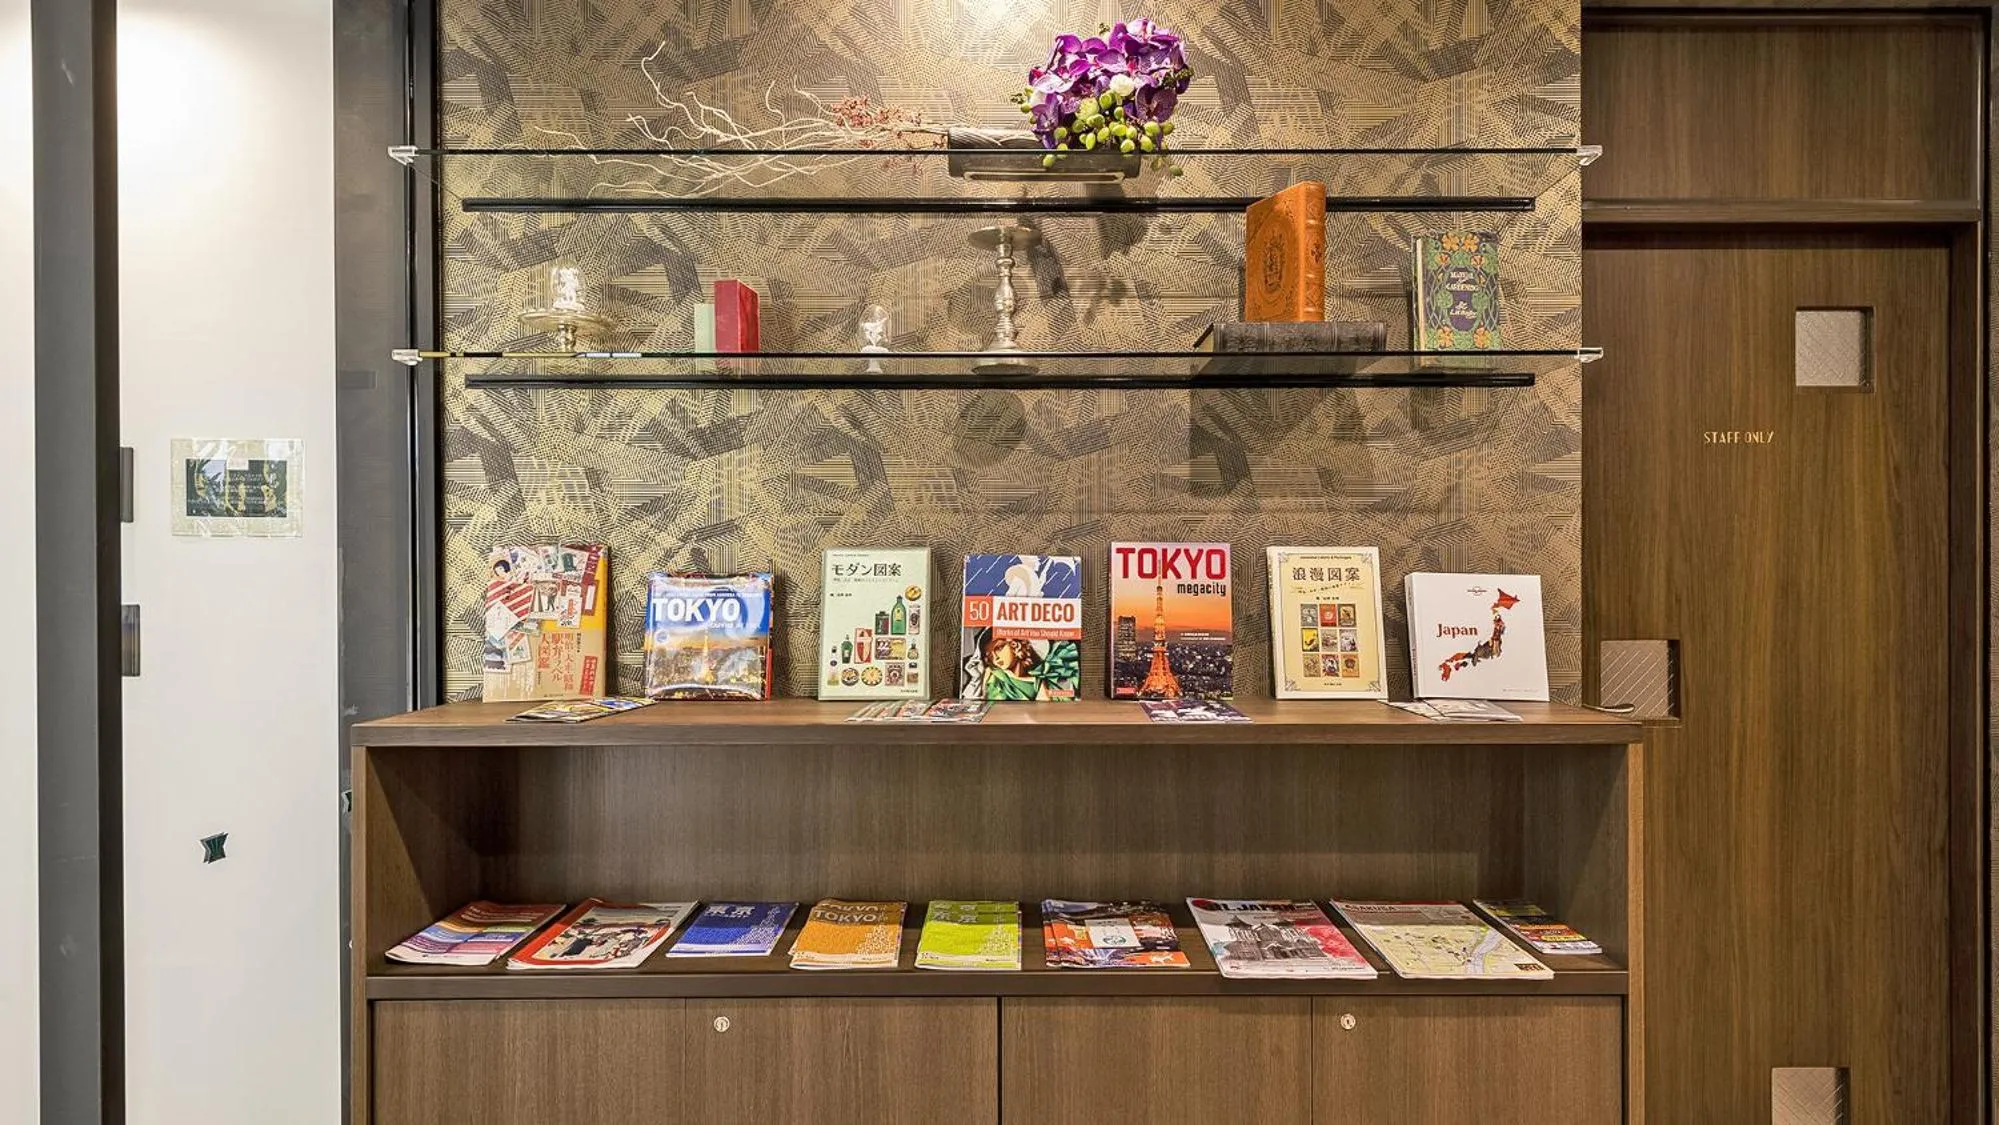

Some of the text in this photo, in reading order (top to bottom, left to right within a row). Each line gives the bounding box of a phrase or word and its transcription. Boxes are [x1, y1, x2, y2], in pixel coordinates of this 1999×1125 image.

[1703, 430, 1775, 444] STAFF ONLY
[831, 563, 902, 577] モダン図案
[1115, 547, 1227, 580] TOKYO
[1292, 567, 1360, 582] 浪漫図案
[1177, 582, 1227, 597] megacity
[652, 597, 740, 622] TOKYO
[968, 601, 1075, 623] 50 ART DECO
[1436, 623, 1478, 639] Japan
[814, 909, 877, 923] TOKYO
